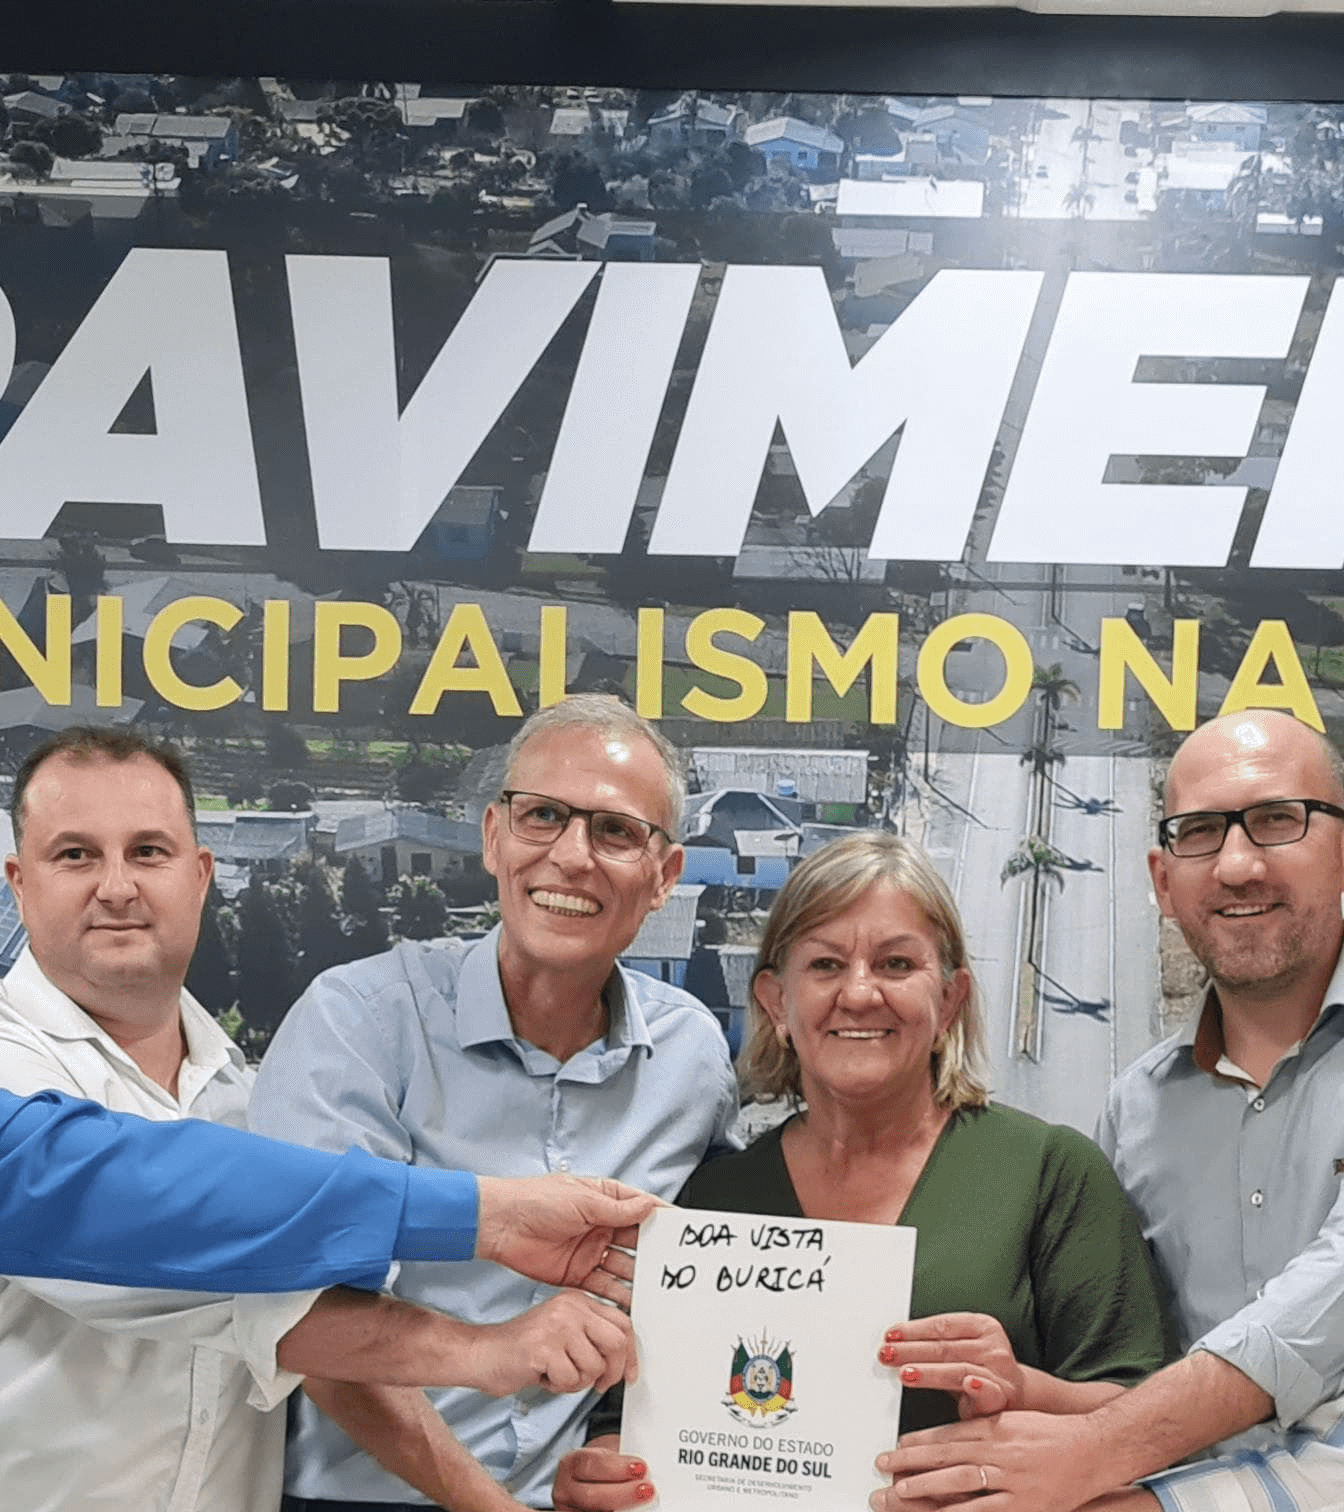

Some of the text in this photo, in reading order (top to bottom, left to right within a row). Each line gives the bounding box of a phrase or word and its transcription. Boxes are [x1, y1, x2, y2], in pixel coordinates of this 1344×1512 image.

[1097, 617, 1326, 734] NA
[679, 1223, 824, 1252] BOA VISTA
[660, 1255, 832, 1293] DO BURICÁ
[678, 1429, 834, 1457] GOVERNO DO ESTADO
[678, 1447, 832, 1479] RIO GRANDE DO SUL
